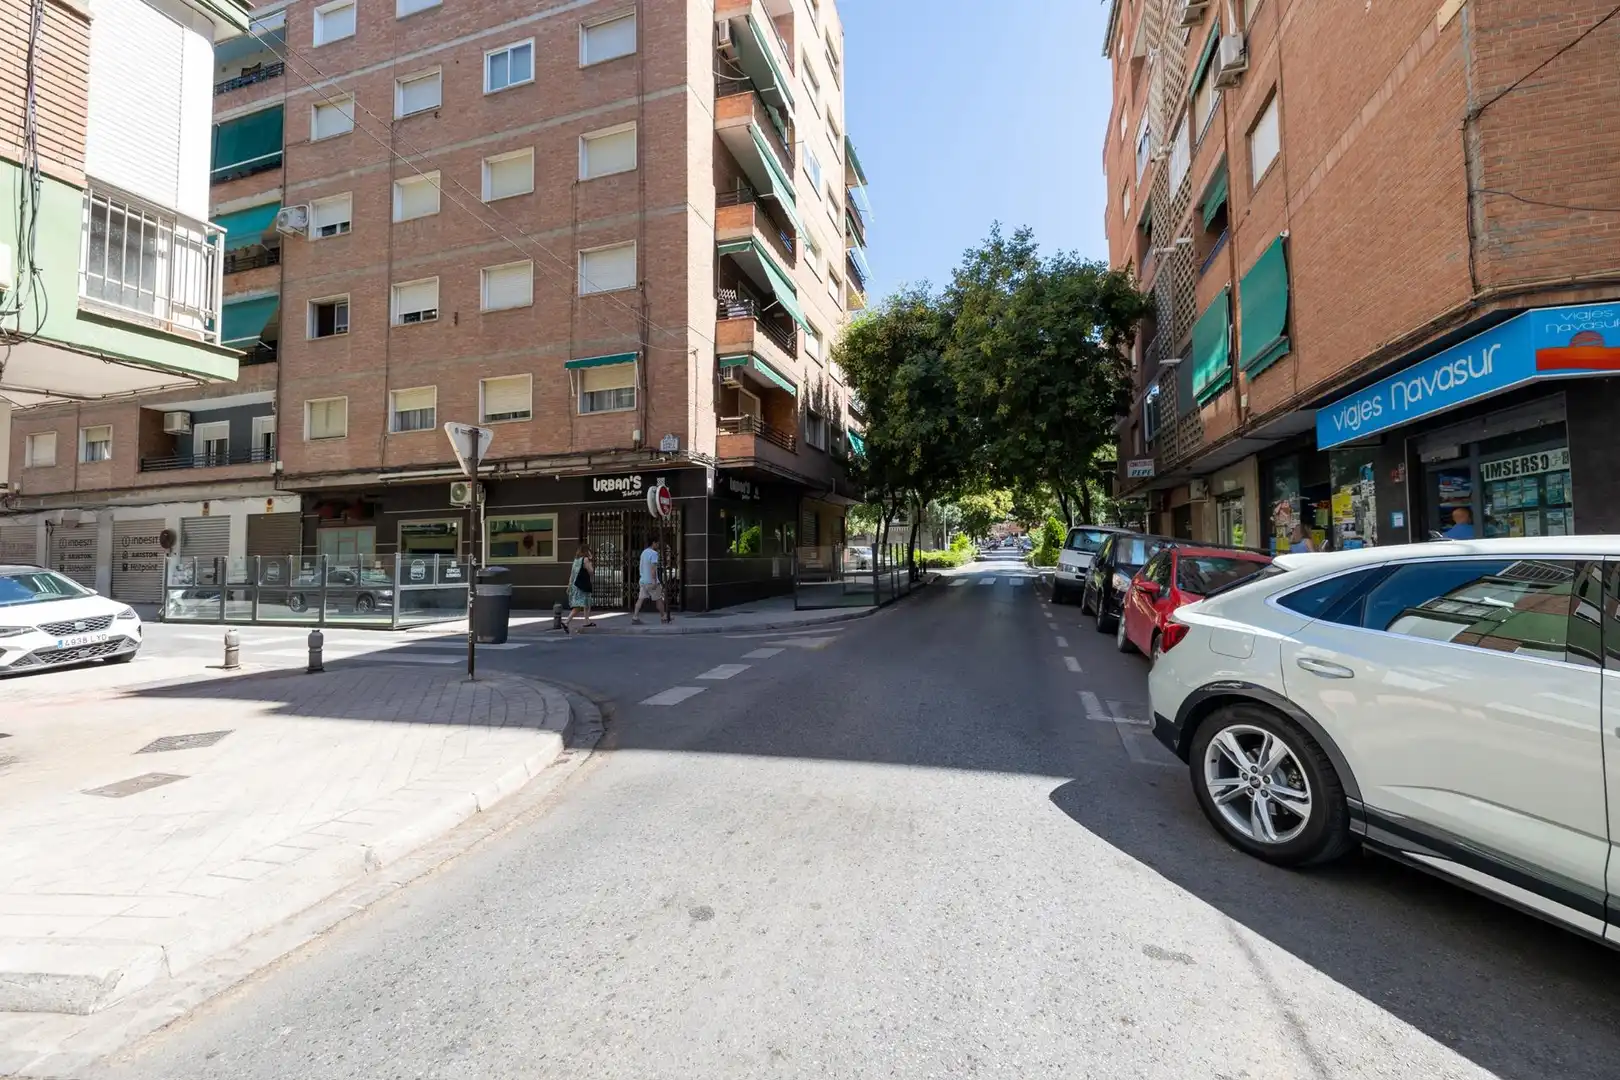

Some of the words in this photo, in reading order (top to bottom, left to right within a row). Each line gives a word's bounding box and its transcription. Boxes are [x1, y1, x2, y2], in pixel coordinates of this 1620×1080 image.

[1560, 309, 1614, 322] viajes
[1333, 395, 1382, 431] viajes
[1391, 343, 1501, 410] navasur
[1485, 454, 1549, 479] IMSERSO
